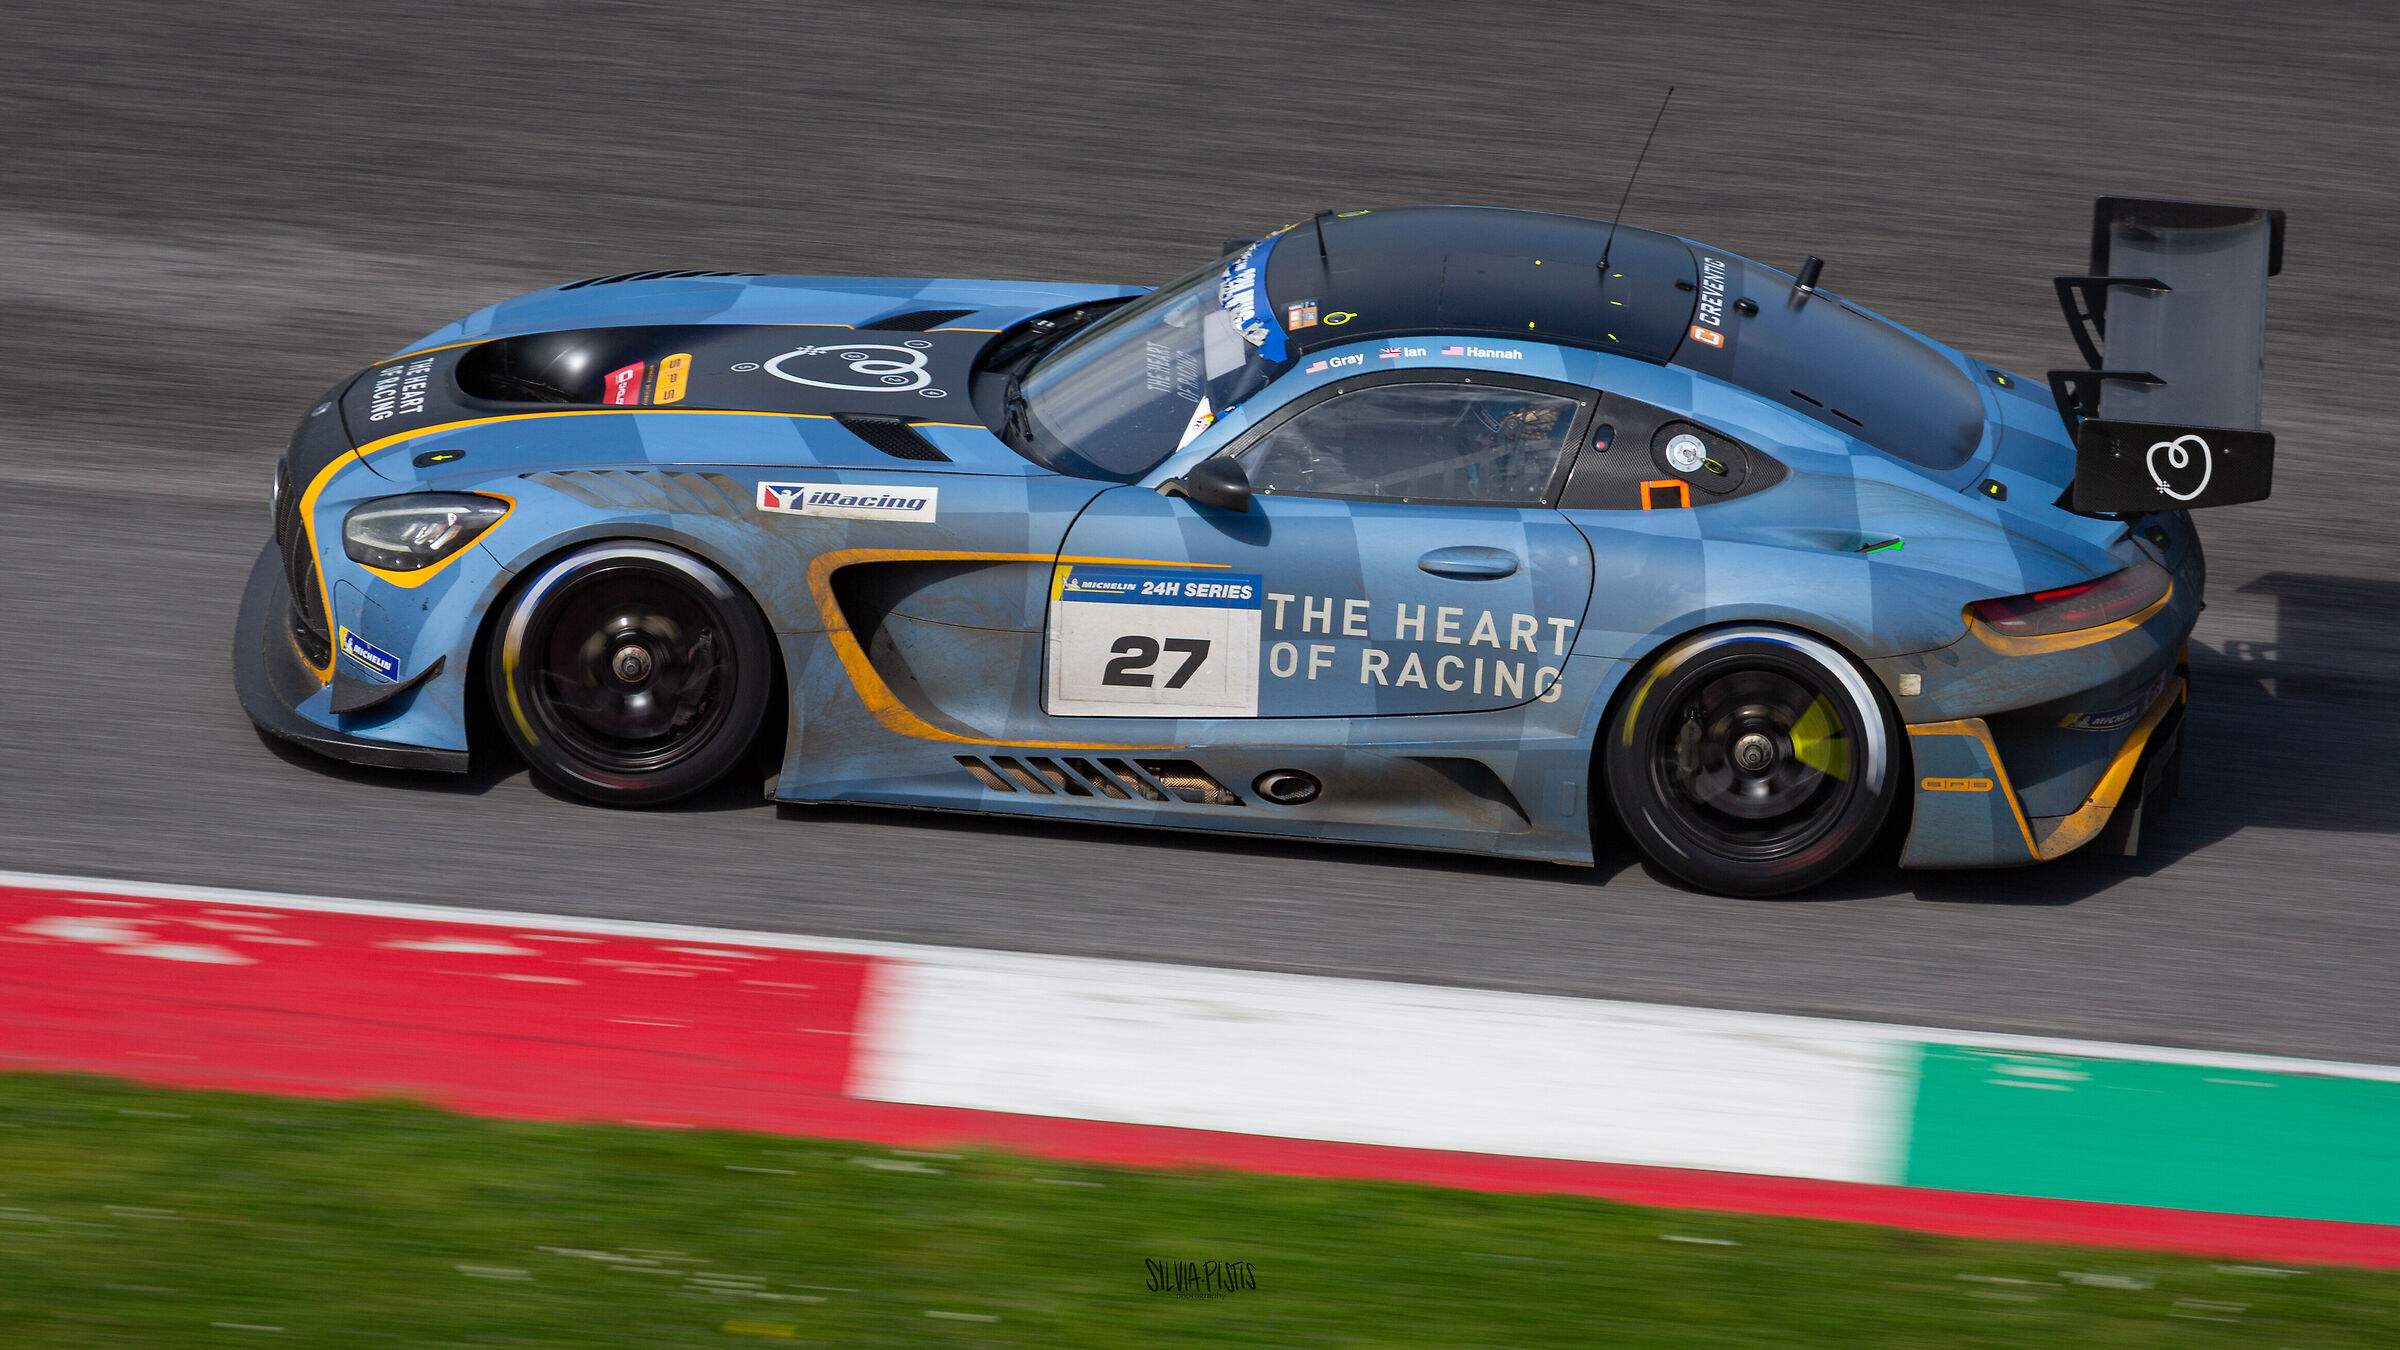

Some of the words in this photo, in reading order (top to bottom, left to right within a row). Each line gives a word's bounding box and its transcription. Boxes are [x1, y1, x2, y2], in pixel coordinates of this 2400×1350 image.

[1699, 257, 1726, 327] CREVENTIC
[1145, 340, 1171, 374] HEART
[1329, 353, 1364, 369] Gray
[1404, 346, 1427, 358] Ian
[1466, 346, 1523, 360] Hannah
[379, 365, 405, 377] OF
[406, 357, 435, 376] THE
[1176, 350, 1199, 390] RACING
[1145, 371, 1171, 393] THE
[1176, 384, 1199, 404] OF
[369, 376, 401, 421] RACING
[399, 375, 429, 414] HEART
[808, 491, 927, 511] iRacing
[1081, 581, 1137, 591] MICHELIN
[1141, 581, 1181, 596] 24H
[1184, 583, 1253, 600] SERIES
[1267, 592, 1371, 637] THE
[1395, 602, 1575, 656] HEART
[353, 644, 392, 671] MICHELIN
[1102, 635, 1211, 689] 27
[1269, 641, 1336, 681] OF
[1360, 648, 1563, 703] RACING
